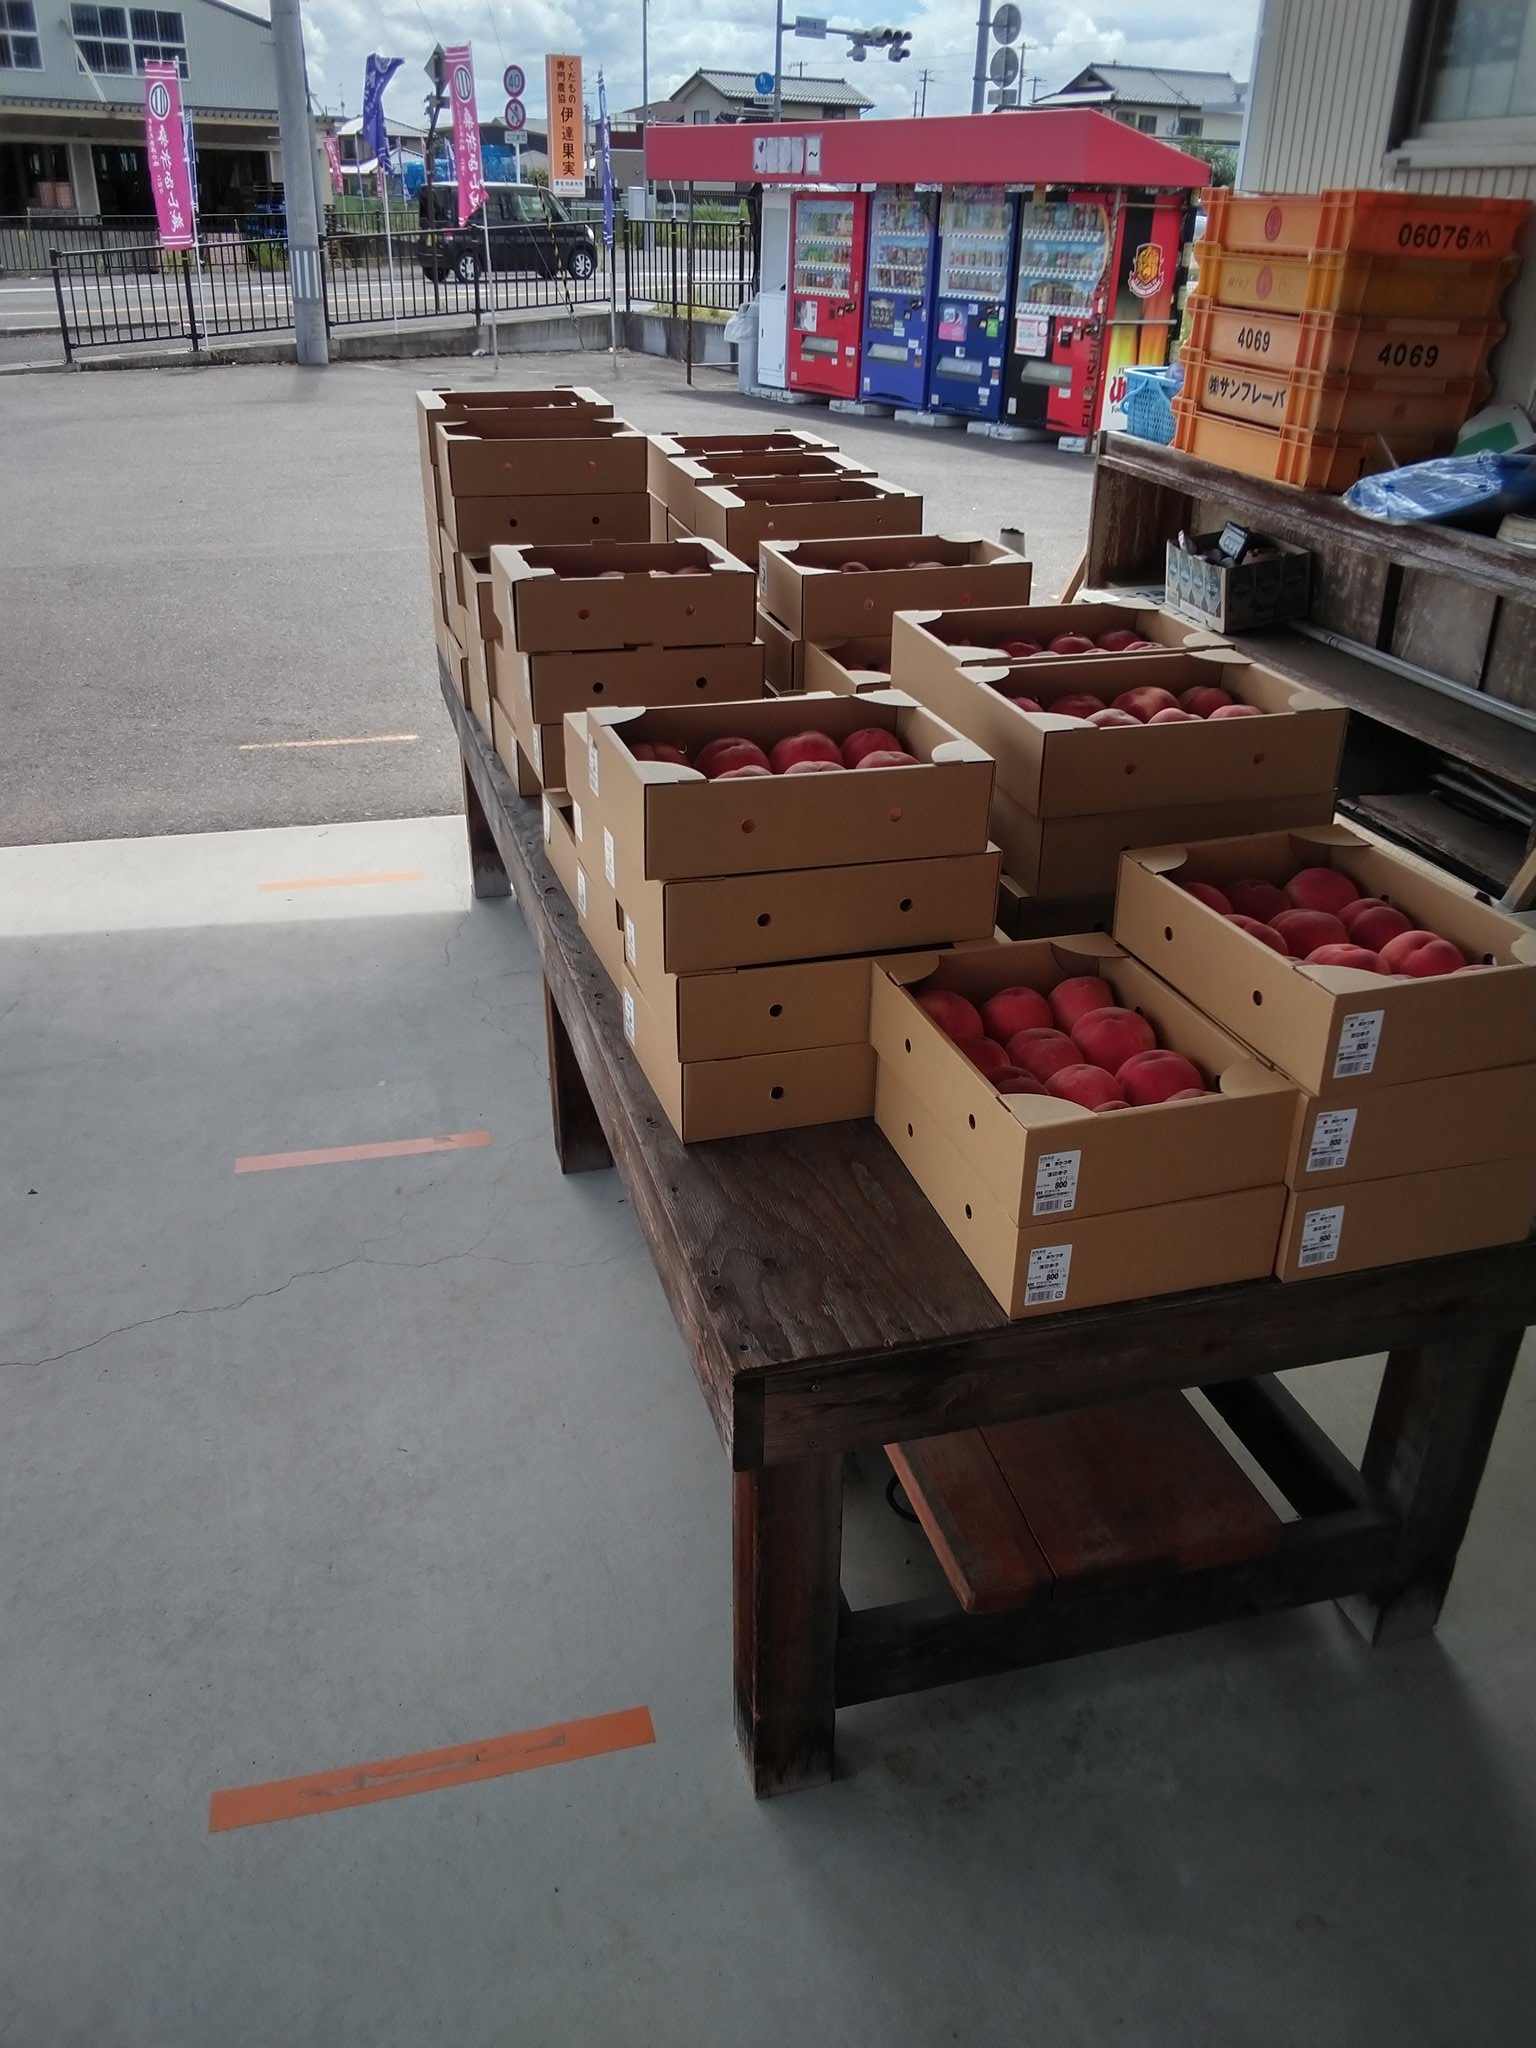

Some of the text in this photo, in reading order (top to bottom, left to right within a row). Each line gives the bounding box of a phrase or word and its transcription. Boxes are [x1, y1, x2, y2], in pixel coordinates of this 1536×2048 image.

[508, 73, 521, 89] 40
[567, 60, 576, 104] くだもの
[560, 106, 575, 176] 伊達果実
[1397, 221, 1471, 250] 06076
[1237, 326, 1271, 353] 4069
[1377, 341, 1440, 369] 4069
[1055, 1180, 1068, 1189] 800
[1046, 1272, 1060, 1281] 800
